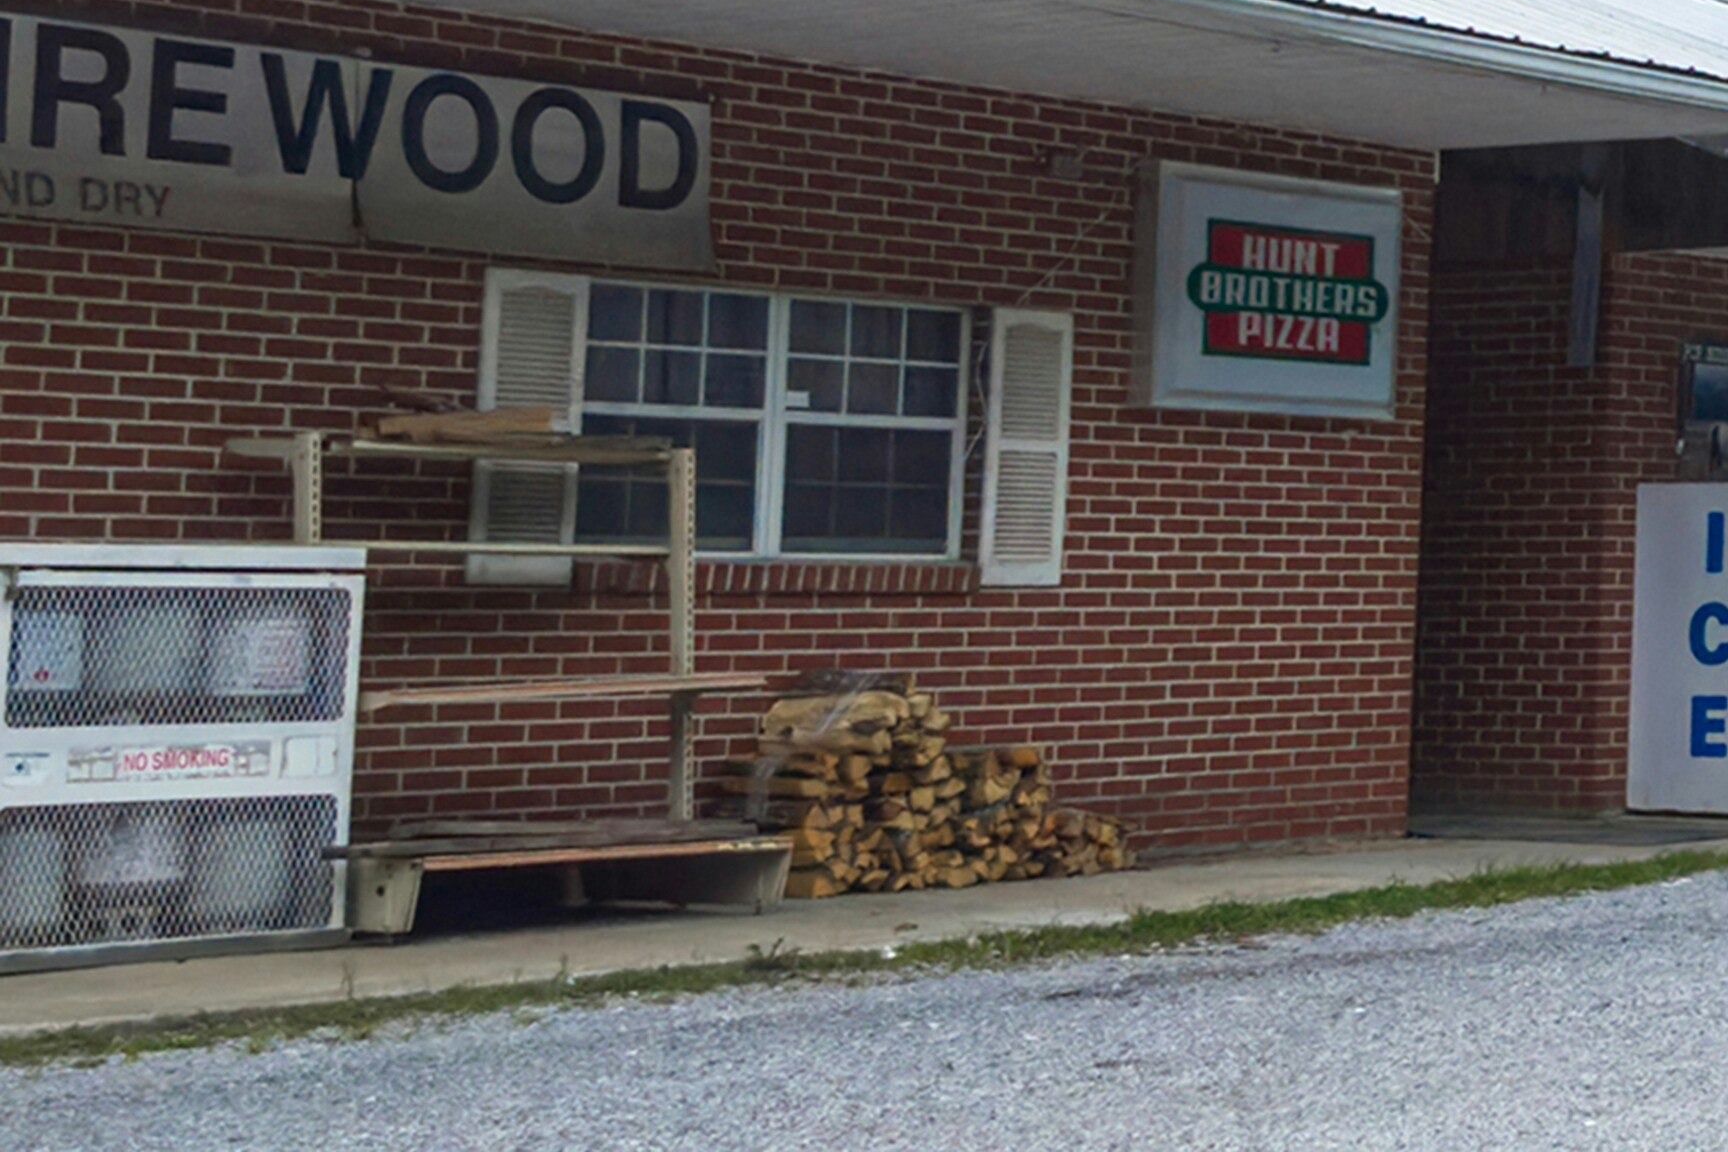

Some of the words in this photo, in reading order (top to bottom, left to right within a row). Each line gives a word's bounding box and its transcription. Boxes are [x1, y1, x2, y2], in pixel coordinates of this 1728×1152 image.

[80, 177, 171, 217] DRY
[1243, 234, 1340, 278] HUNT
[1201, 270, 1378, 317] BROTHERS
[1238, 310, 1339, 352] PIZZA
[123, 753, 149, 772] NO
[152, 748, 231, 772] SMOKING
